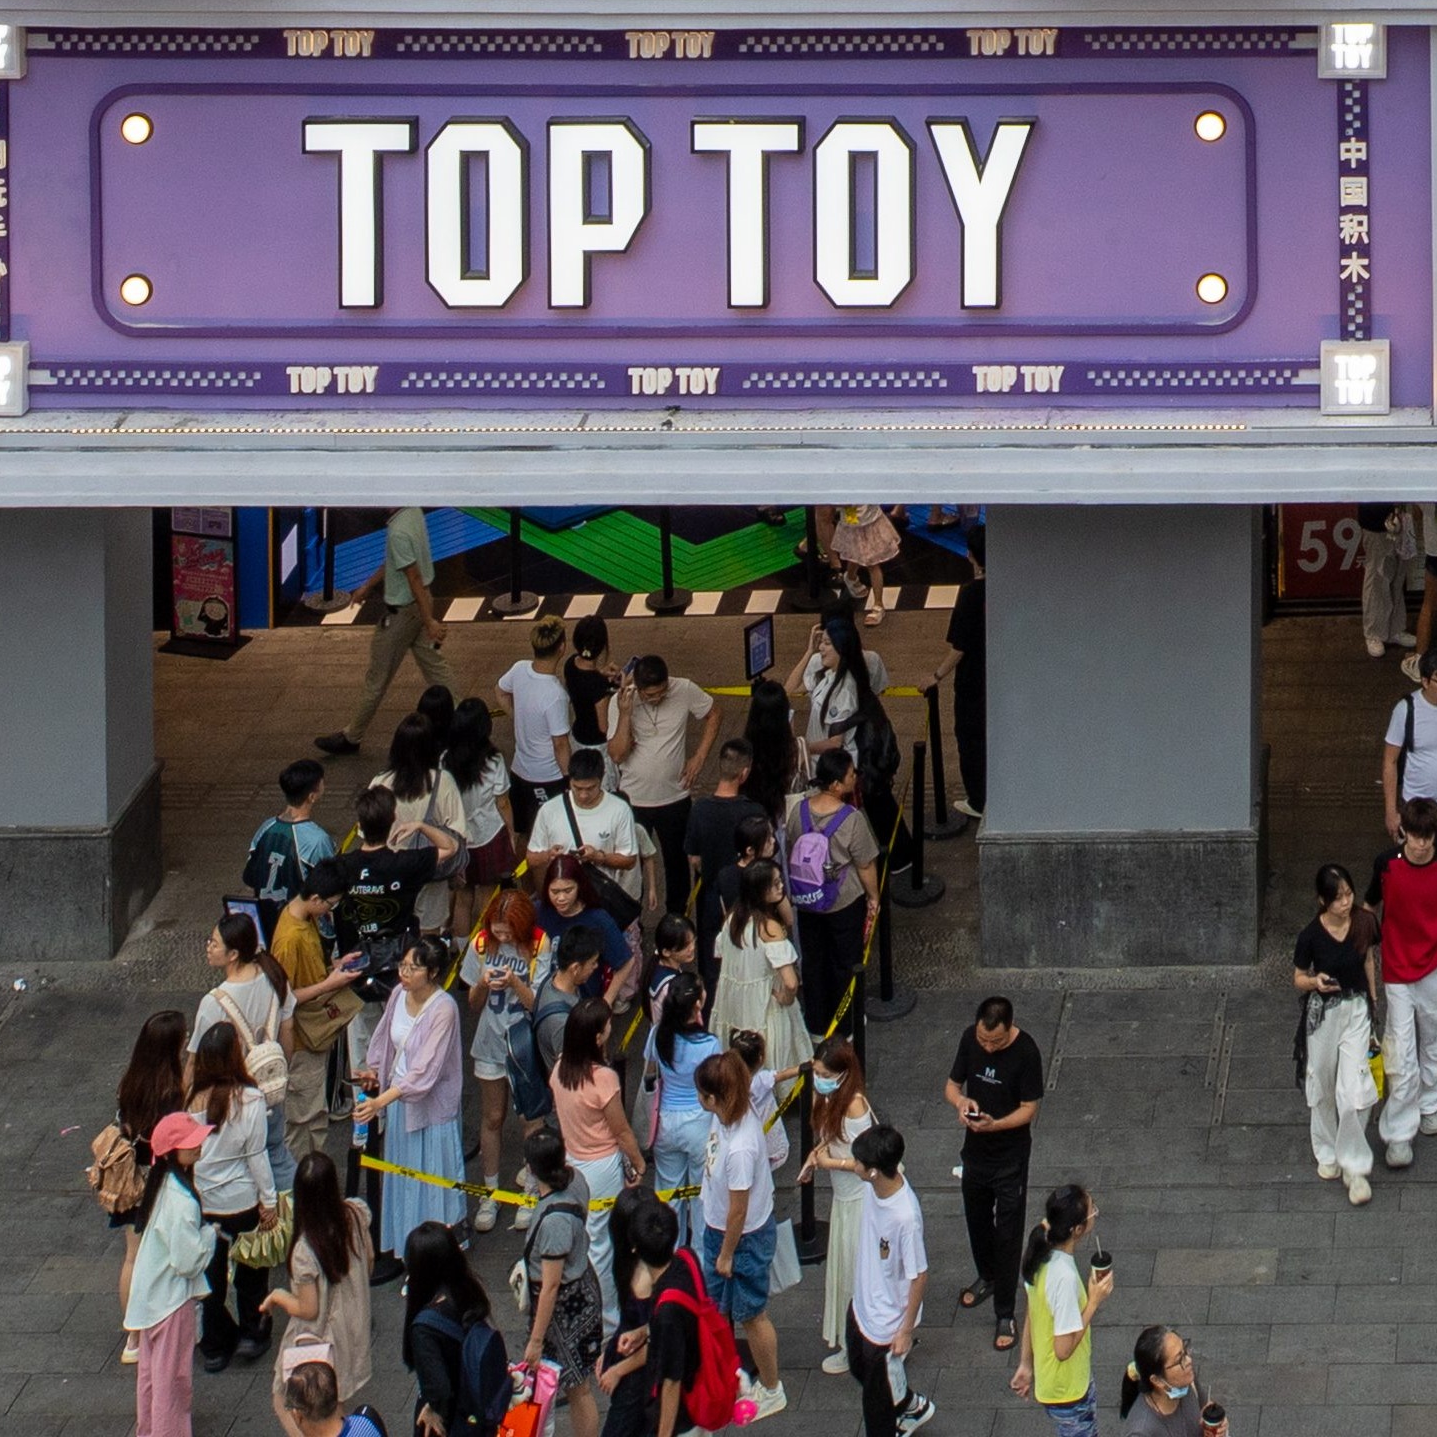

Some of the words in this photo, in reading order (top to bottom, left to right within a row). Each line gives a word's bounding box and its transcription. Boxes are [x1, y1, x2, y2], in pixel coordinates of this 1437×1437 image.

[282, 29, 328, 57] TOP
[330, 29, 374, 57] TOY
[966, 28, 1013, 57] TOP
[1014, 28, 1059, 57] TOY
[1331, 23, 1375, 44] TOP
[1331, 44, 1375, 70] TOY
[301, 115, 652, 310] TOP
[690, 115, 1040, 310] TOY
[1339, 137, 1371, 283] 中国积木
[286, 364, 332, 395] TOP
[334, 364, 379, 395] TOY
[971, 364, 1019, 394] TOP
[1021, 364, 1064, 394] TOY
[1335, 354, 1377, 379] TOP
[1335, 379, 1377, 405] TOY
[1297, 518, 1362, 573] 59
